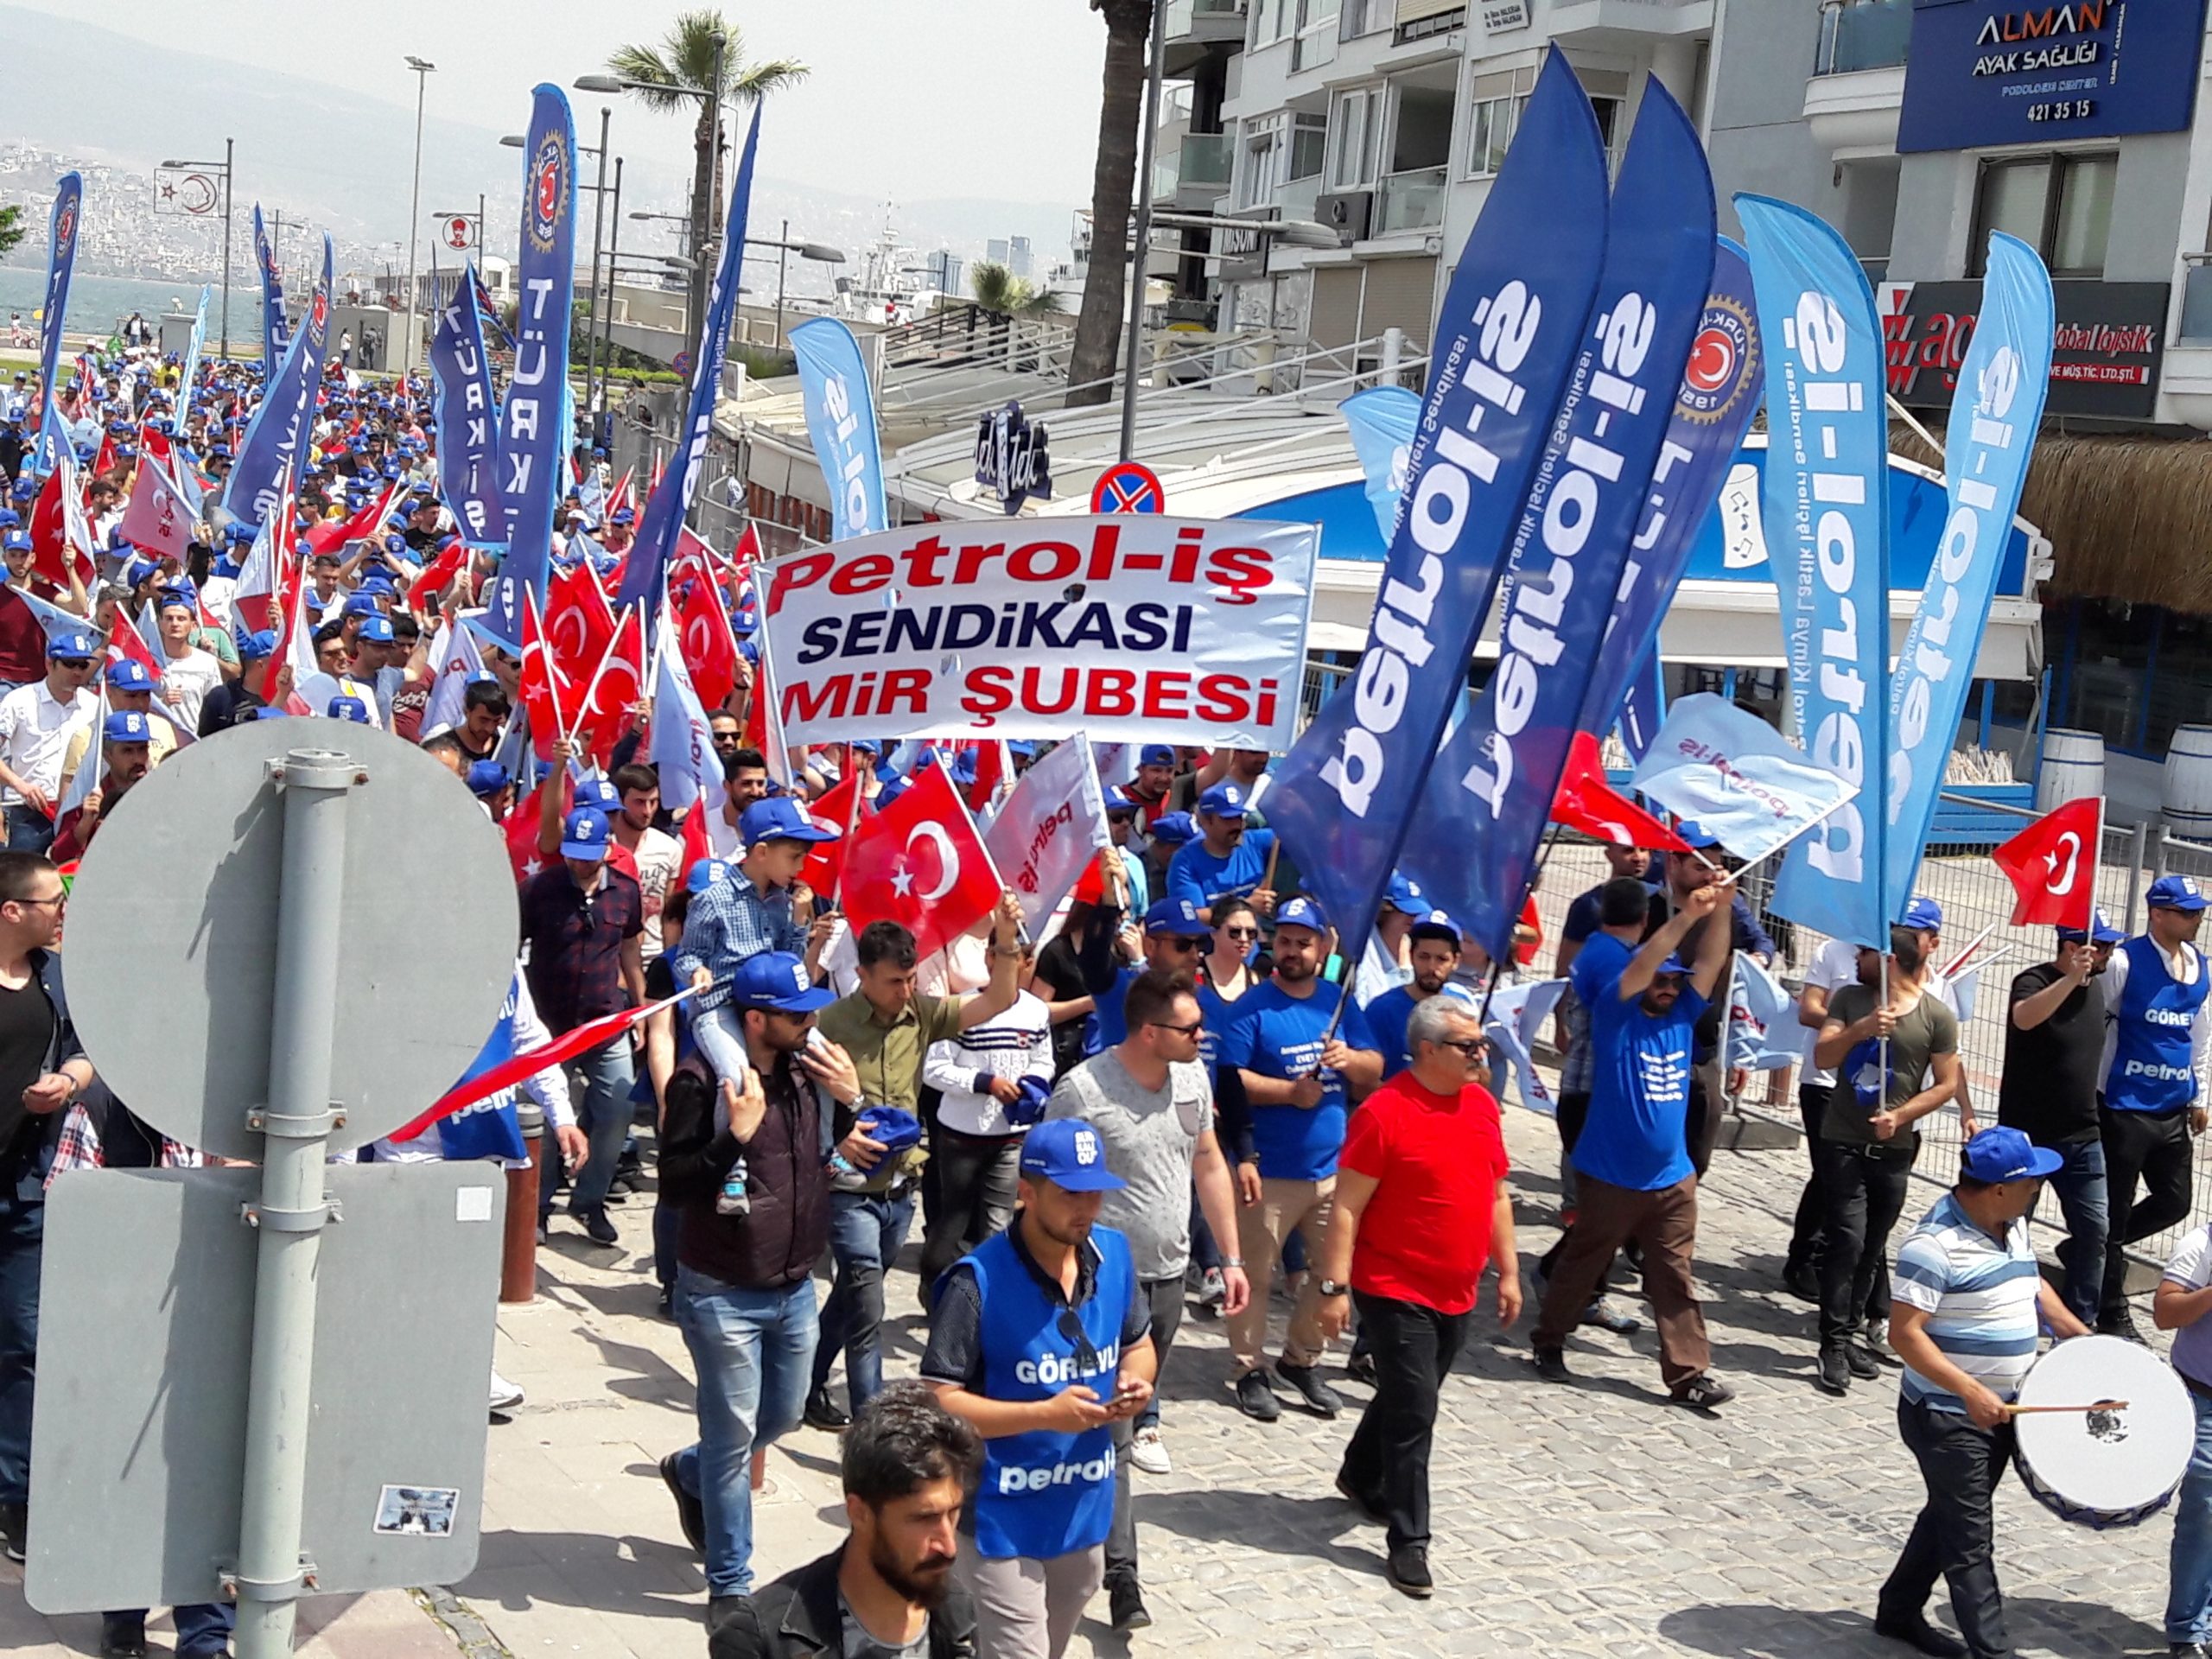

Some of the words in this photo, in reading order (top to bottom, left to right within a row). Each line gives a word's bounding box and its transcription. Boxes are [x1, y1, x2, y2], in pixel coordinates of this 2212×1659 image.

[1975, 0, 2103, 46] ALMAN
[1972, 52, 2019, 76] AYAK
[2021, 40, 2098, 71] SAĞLIĞI
[2027, 104, 2050, 122] 421
[2053, 101, 2070, 119] 35
[2076, 99, 2091, 118] 15
